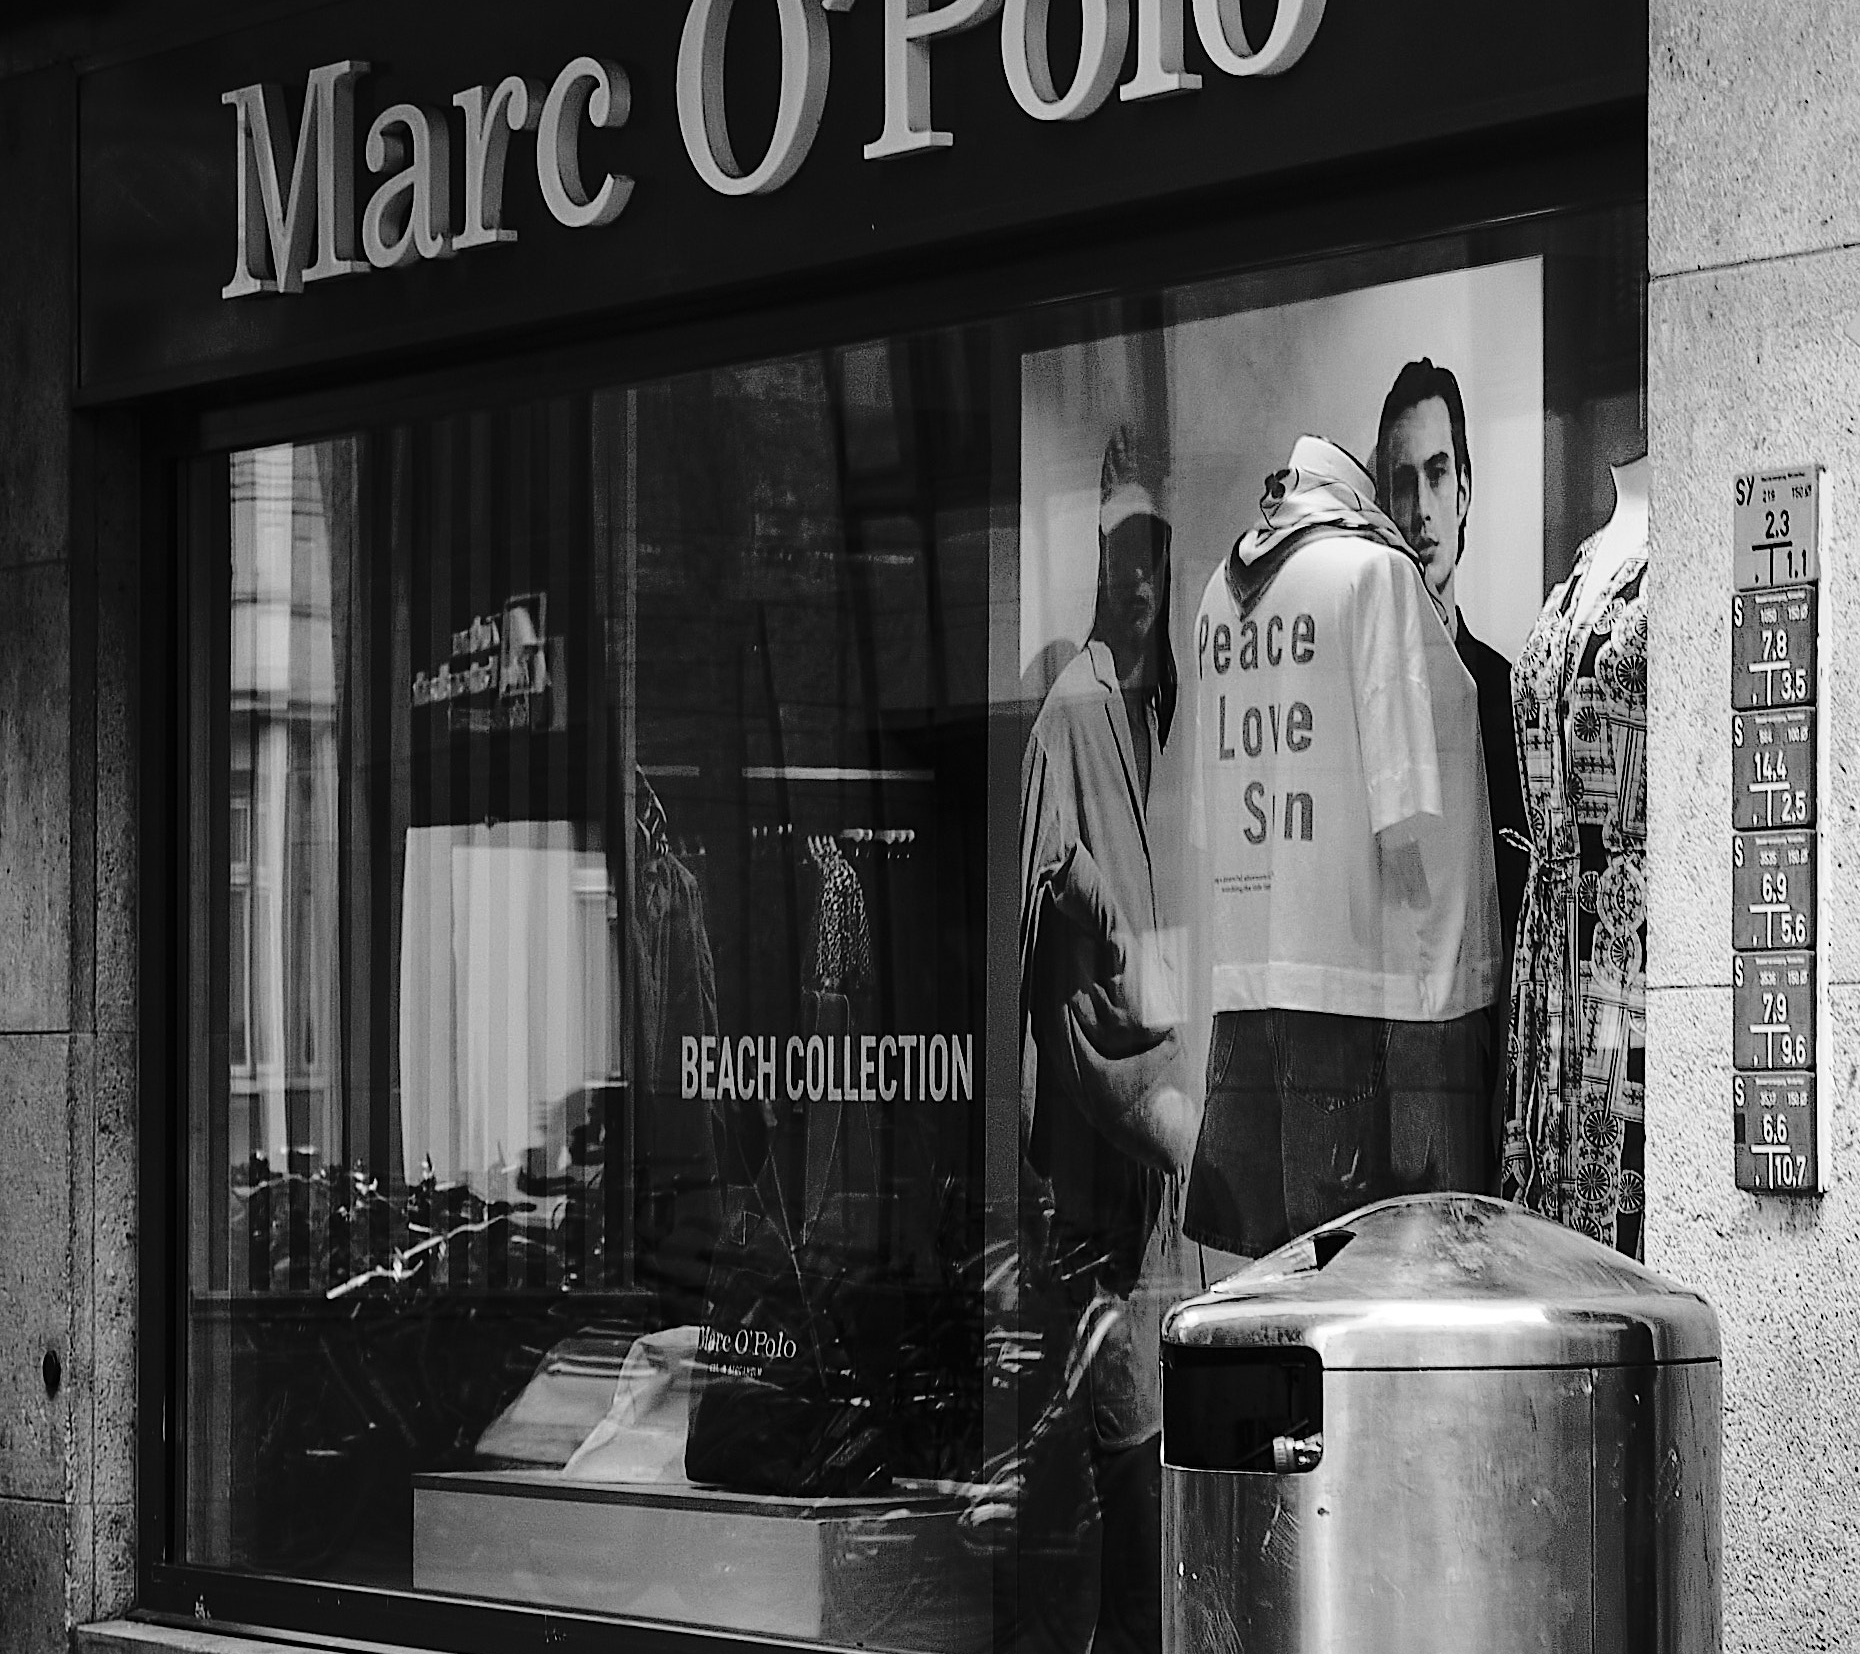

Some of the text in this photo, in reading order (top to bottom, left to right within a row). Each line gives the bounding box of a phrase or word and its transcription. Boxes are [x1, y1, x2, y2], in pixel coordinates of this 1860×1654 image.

[222, 56, 636, 300] Marc
[1733, 595, 1744, 628] S
[1198, 613, 1316, 681] Peace
[1219, 695, 1313, 760] Love
[1733, 716, 1744, 748] S
[1734, 836, 1744, 867] S
[1734, 957, 1744, 987] S
[681, 1033, 974, 1103] BEACH COLLECTION
[1734, 1075, 1745, 1107] S
[699, 1325, 797, 1359] Marc O'Polo
